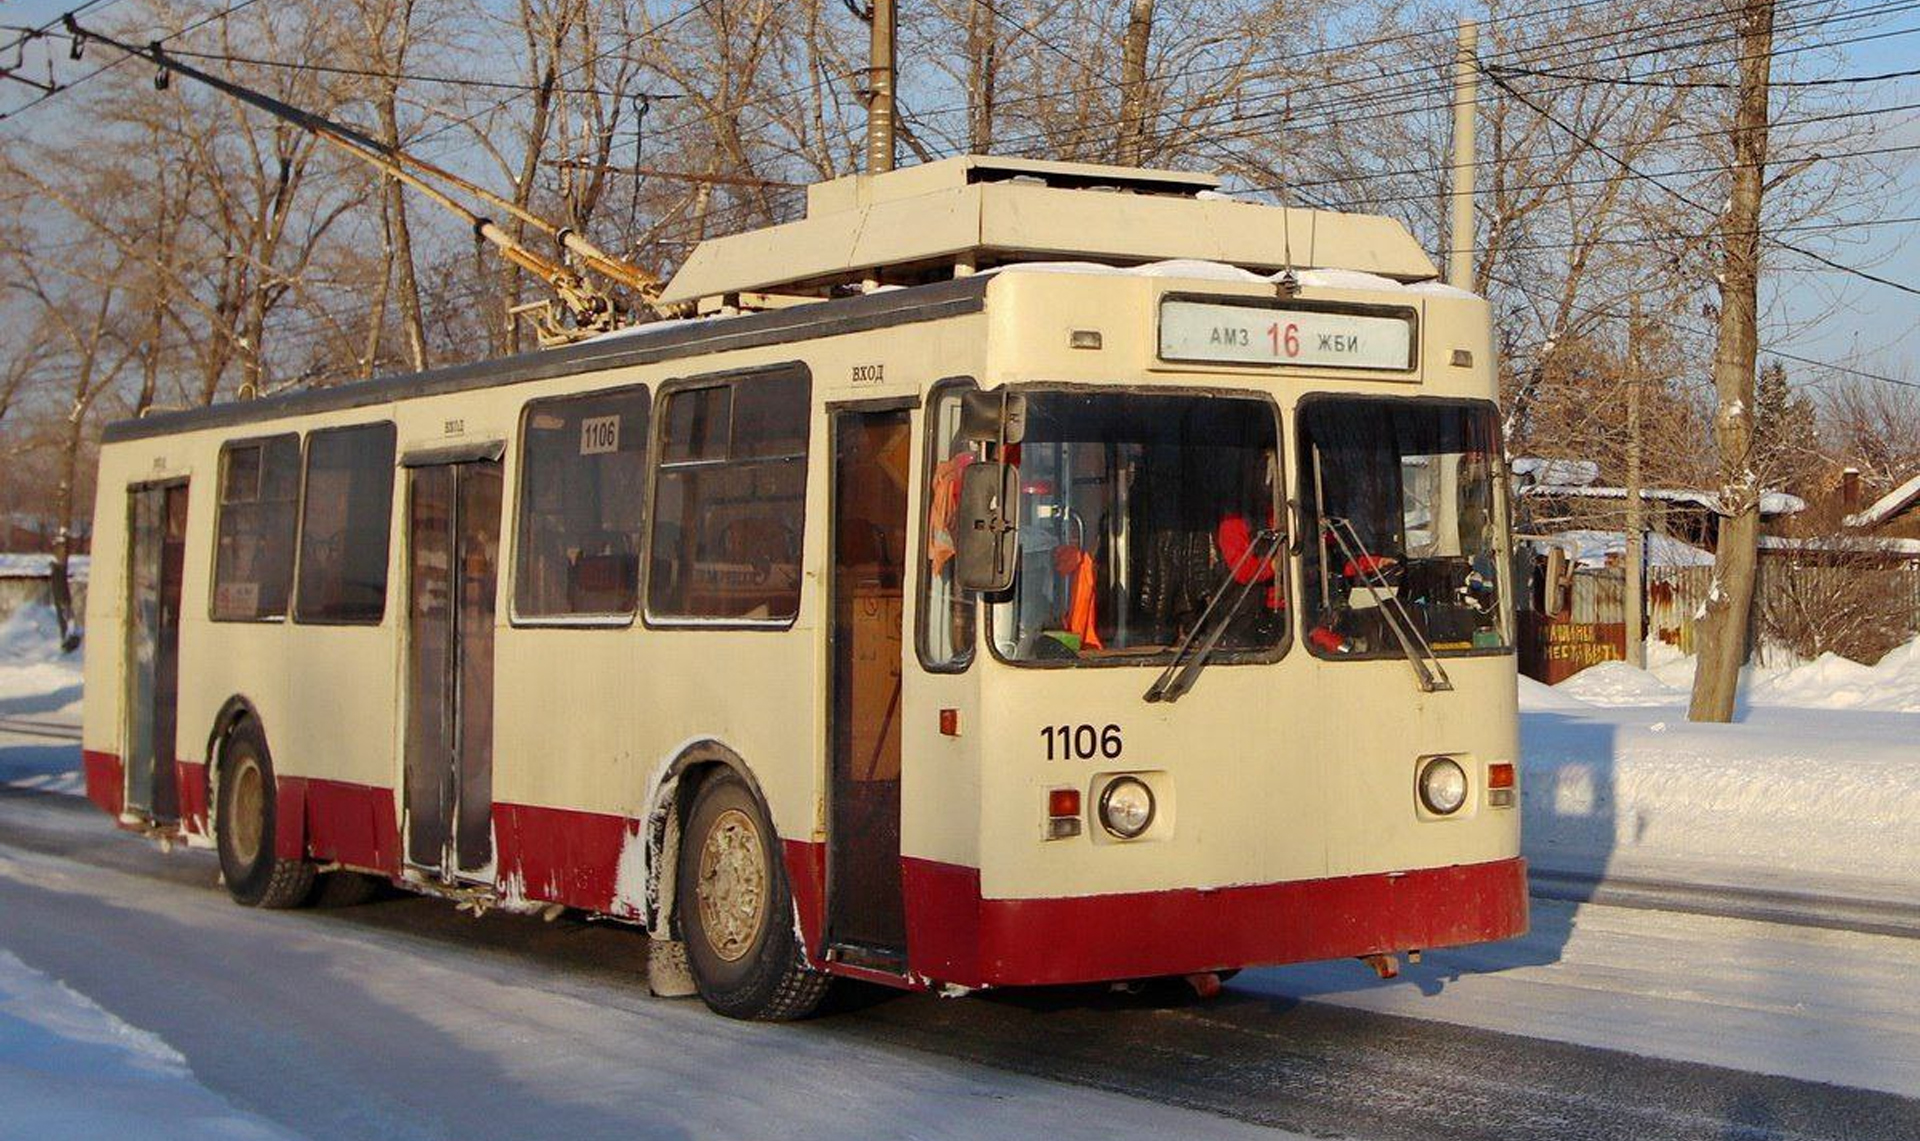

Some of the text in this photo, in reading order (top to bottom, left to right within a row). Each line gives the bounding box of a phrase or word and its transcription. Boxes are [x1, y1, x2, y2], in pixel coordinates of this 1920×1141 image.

[1209, 322, 1358, 358] АМЗ 16 ЖБИ
[852, 364, 884, 384] ВХОД
[585, 421, 615, 448] 1106
[1041, 724, 1122, 760] 1106
